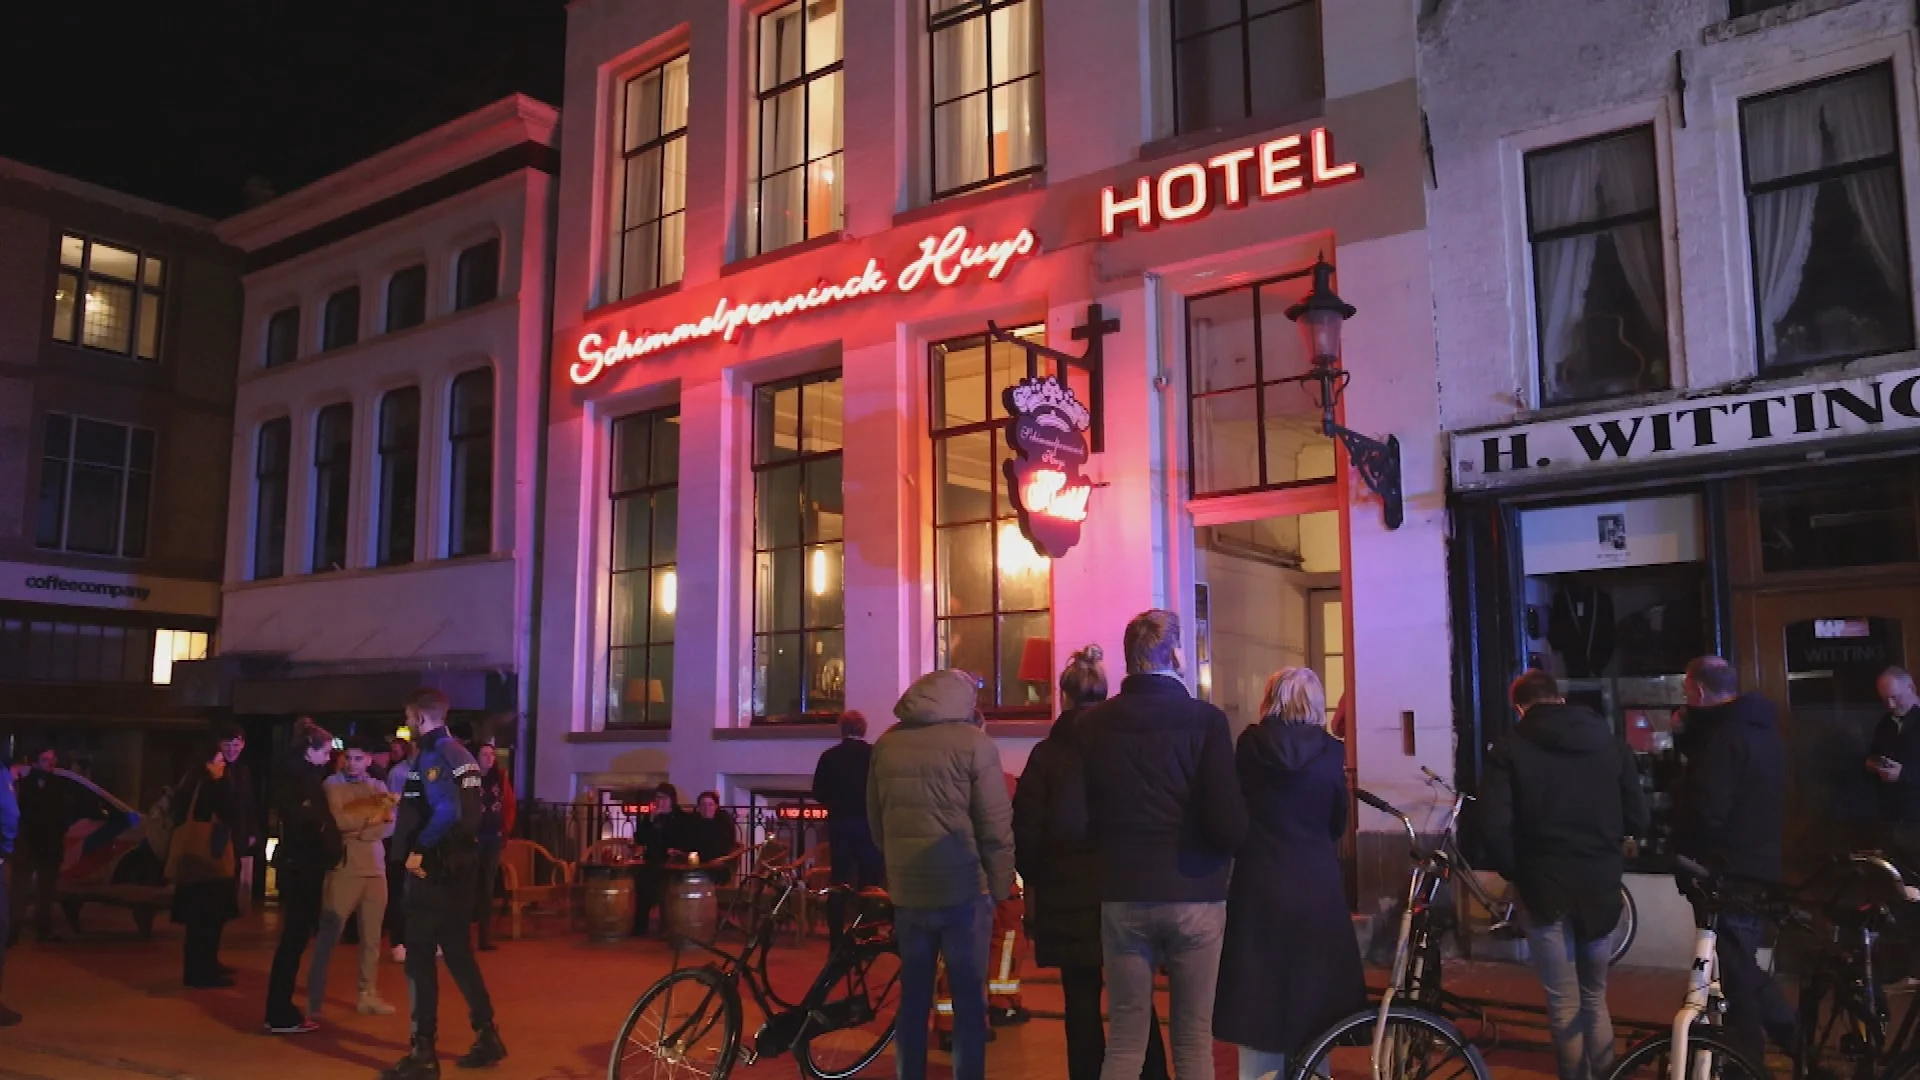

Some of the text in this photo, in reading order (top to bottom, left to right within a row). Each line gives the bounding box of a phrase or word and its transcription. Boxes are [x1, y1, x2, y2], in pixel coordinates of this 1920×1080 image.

[1100, 127, 1361, 237] HOTEL
[569, 225, 1036, 385] Schimmelpenninck Huys
[1481, 432, 1551, 474] H.
[26, 575, 150, 600] coffeecompany
